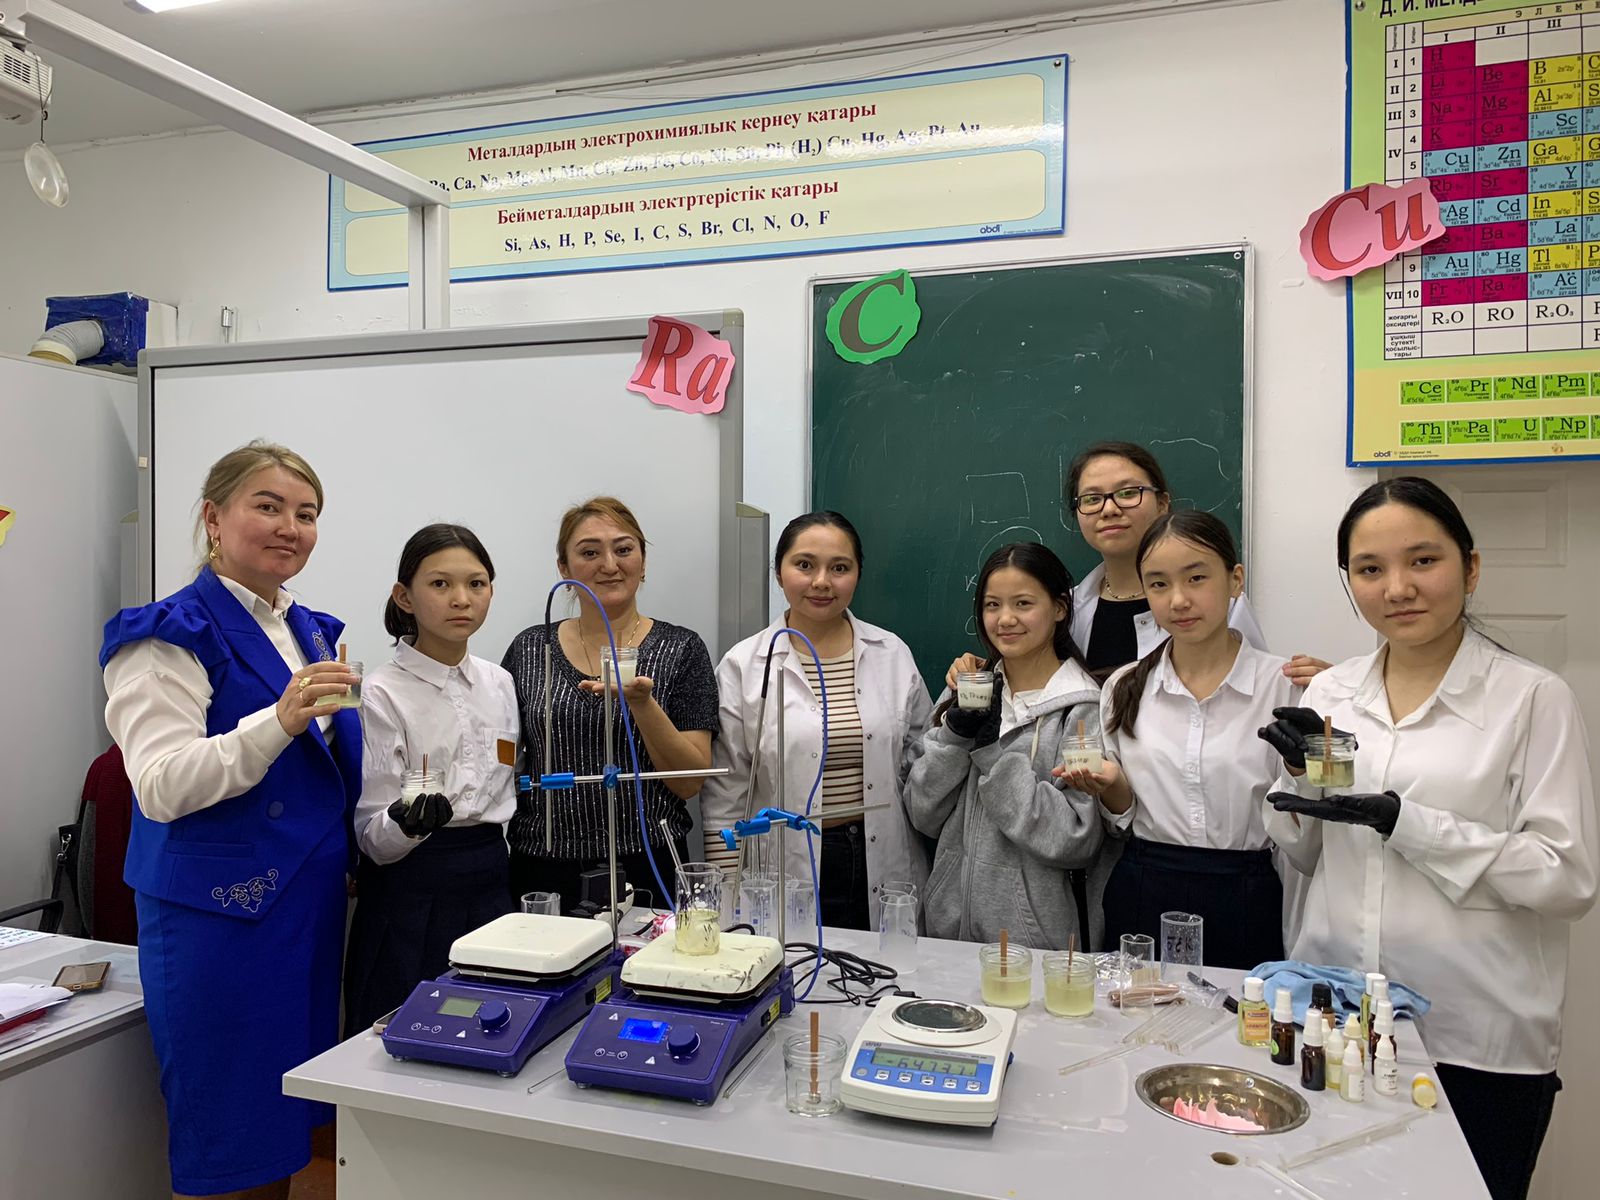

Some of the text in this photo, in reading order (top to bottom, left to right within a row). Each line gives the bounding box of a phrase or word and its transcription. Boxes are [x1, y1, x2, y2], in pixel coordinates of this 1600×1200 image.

[1410, 57, 1416, 66] 1
[1534, 61, 1547, 75] B
[1390, 86, 1400, 95] II
[1410, 84, 1416, 93] 2
[1534, 88, 1552, 103] Al
[1388, 111, 1402, 121] III
[1410, 109, 1416, 118] 3
[1556, 113, 1578, 127] Sc
[468, 105, 877, 161] Металдардың электрохимиялық кернеу қатары
[1410, 135, 1417, 144] 4
[1388, 149, 1402, 158] IV
[1498, 146, 1521, 160] Zn
[1533, 143, 1558, 156] Ga
[1410, 161, 1417, 170] 5
[1445, 152, 1469, 166] Cu
[1565, 166, 1577, 179] Y
[454, 176, 476, 191] Ca,
[497, 182, 839, 225] Бейметалдардың электртерістік қатары
[1497, 198, 1520, 213] Cd
[1533, 196, 1551, 209] In
[1446, 204, 1469, 220] Ag
[505, 210, 830, 254] Si, As, H, P, Se, I, C, S, Br, Cl, N, O, F
[1311, 186, 1432, 271] Cu
[1497, 252, 1521, 267] Hg
[1533, 248, 1551, 262] Tl
[1409, 264, 1416, 273] 9
[1445, 256, 1469, 269] Au
[1386, 291, 1402, 300] VII
[1407, 289, 1419, 299] 10
[839, 273, 906, 353] C
[1488, 307, 1514, 321] RO
[631, 319, 728, 404] Ra
[1419, 381, 1442, 395] Ce
[1470, 379, 1489, 392] Pr
[1511, 376, 1537, 390] Nd
[1557, 375, 1586, 388] Pm
[1418, 422, 1442, 436] Th
[1467, 421, 1489, 434] Pa
[1523, 418, 1537, 432] U
[1560, 417, 1587, 433] Np
